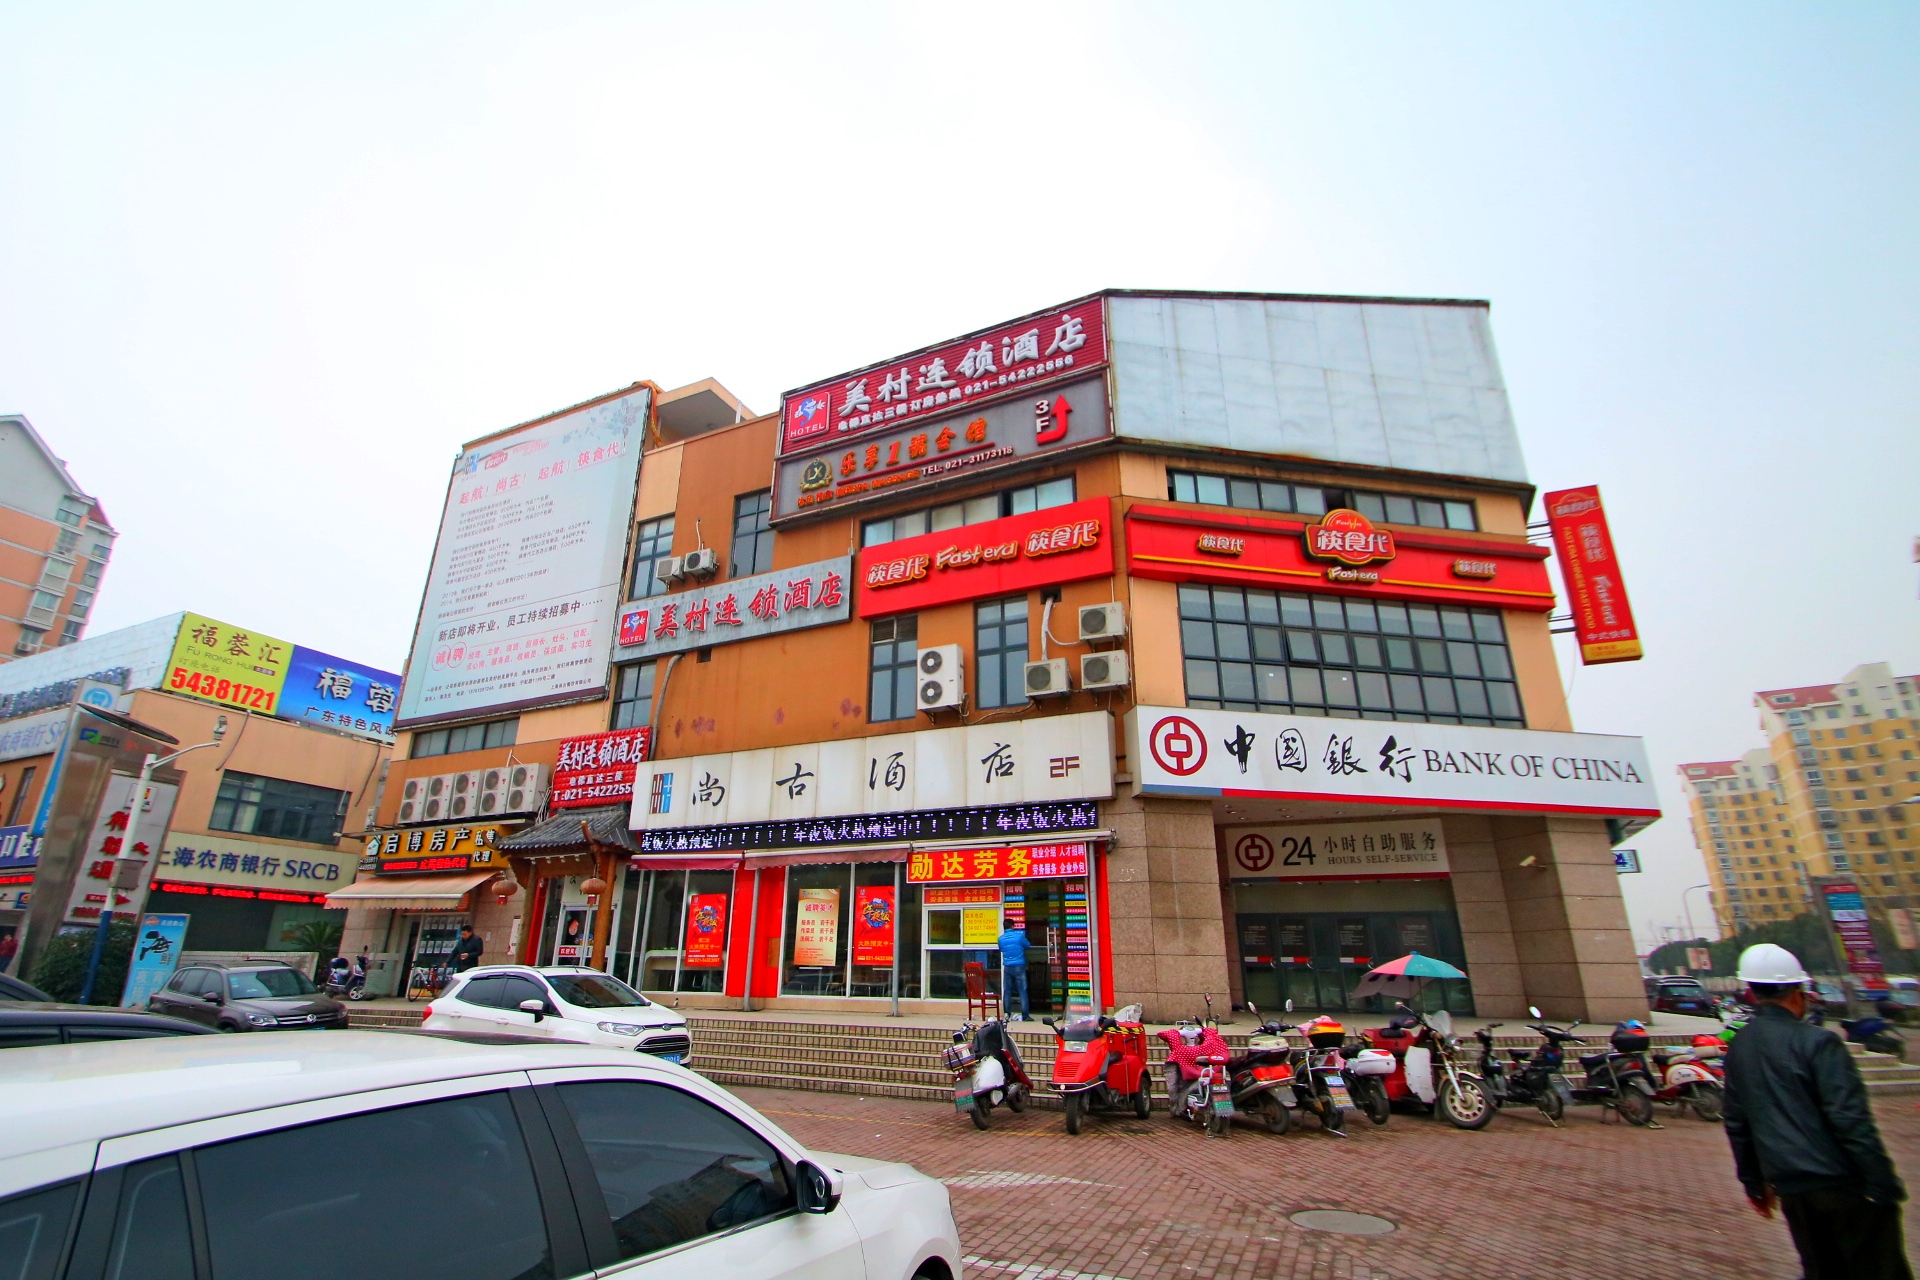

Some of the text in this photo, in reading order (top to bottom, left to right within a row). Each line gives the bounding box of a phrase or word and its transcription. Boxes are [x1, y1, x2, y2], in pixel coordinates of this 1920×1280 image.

[838, 314, 1088, 416] 美村连锁酒店
[965, 354, 1075, 396] 021-54222556
[789, 422, 826, 438] HOTEL
[945, 446, 1014, 471] 021-31173118
[1028, 521, 1098, 553] 筷食代
[1201, 534, 1245, 554] 筷食代
[1317, 529, 1388, 553] 筷食代
[936, 545, 984, 568] Fast
[868, 554, 926, 585] 筷食代
[653, 571, 843, 639] 美村连锁酒店
[191, 623, 282, 665] 福蓉汇
[619, 635, 644, 645] HOTEL
[187, 645, 201, 656] FU
[205, 652, 233, 666] RONG
[171, 666, 276, 711] 54381721
[314, 667, 396, 713] 福蓉
[556, 732, 645, 772] 美村连锁酒店
[692, 742, 1015, 808] 尚古酒店
[1049, 755, 1080, 778] 2F
[1425, 749, 1505, 777] BANK
[1510, 754, 1544, 779] OF
[1553, 757, 1644, 784] CHINA
[383, 828, 470, 853] 启博房产
[1031, 844, 1085, 858] 职业介绍 人才招聘
[1281, 831, 1437, 866] 24 小时自助服务
[283, 859, 339, 881] SRCB
[910, 849, 1032, 880] 勋达劳务
[1032, 862, 1085, 876] 劳务服务 企业外包
[1328, 853, 1438, 865] HOURS SELF-SERVICE
[1006, 885, 1023, 893] 招聘
[1066, 884, 1084, 892] 招聘
